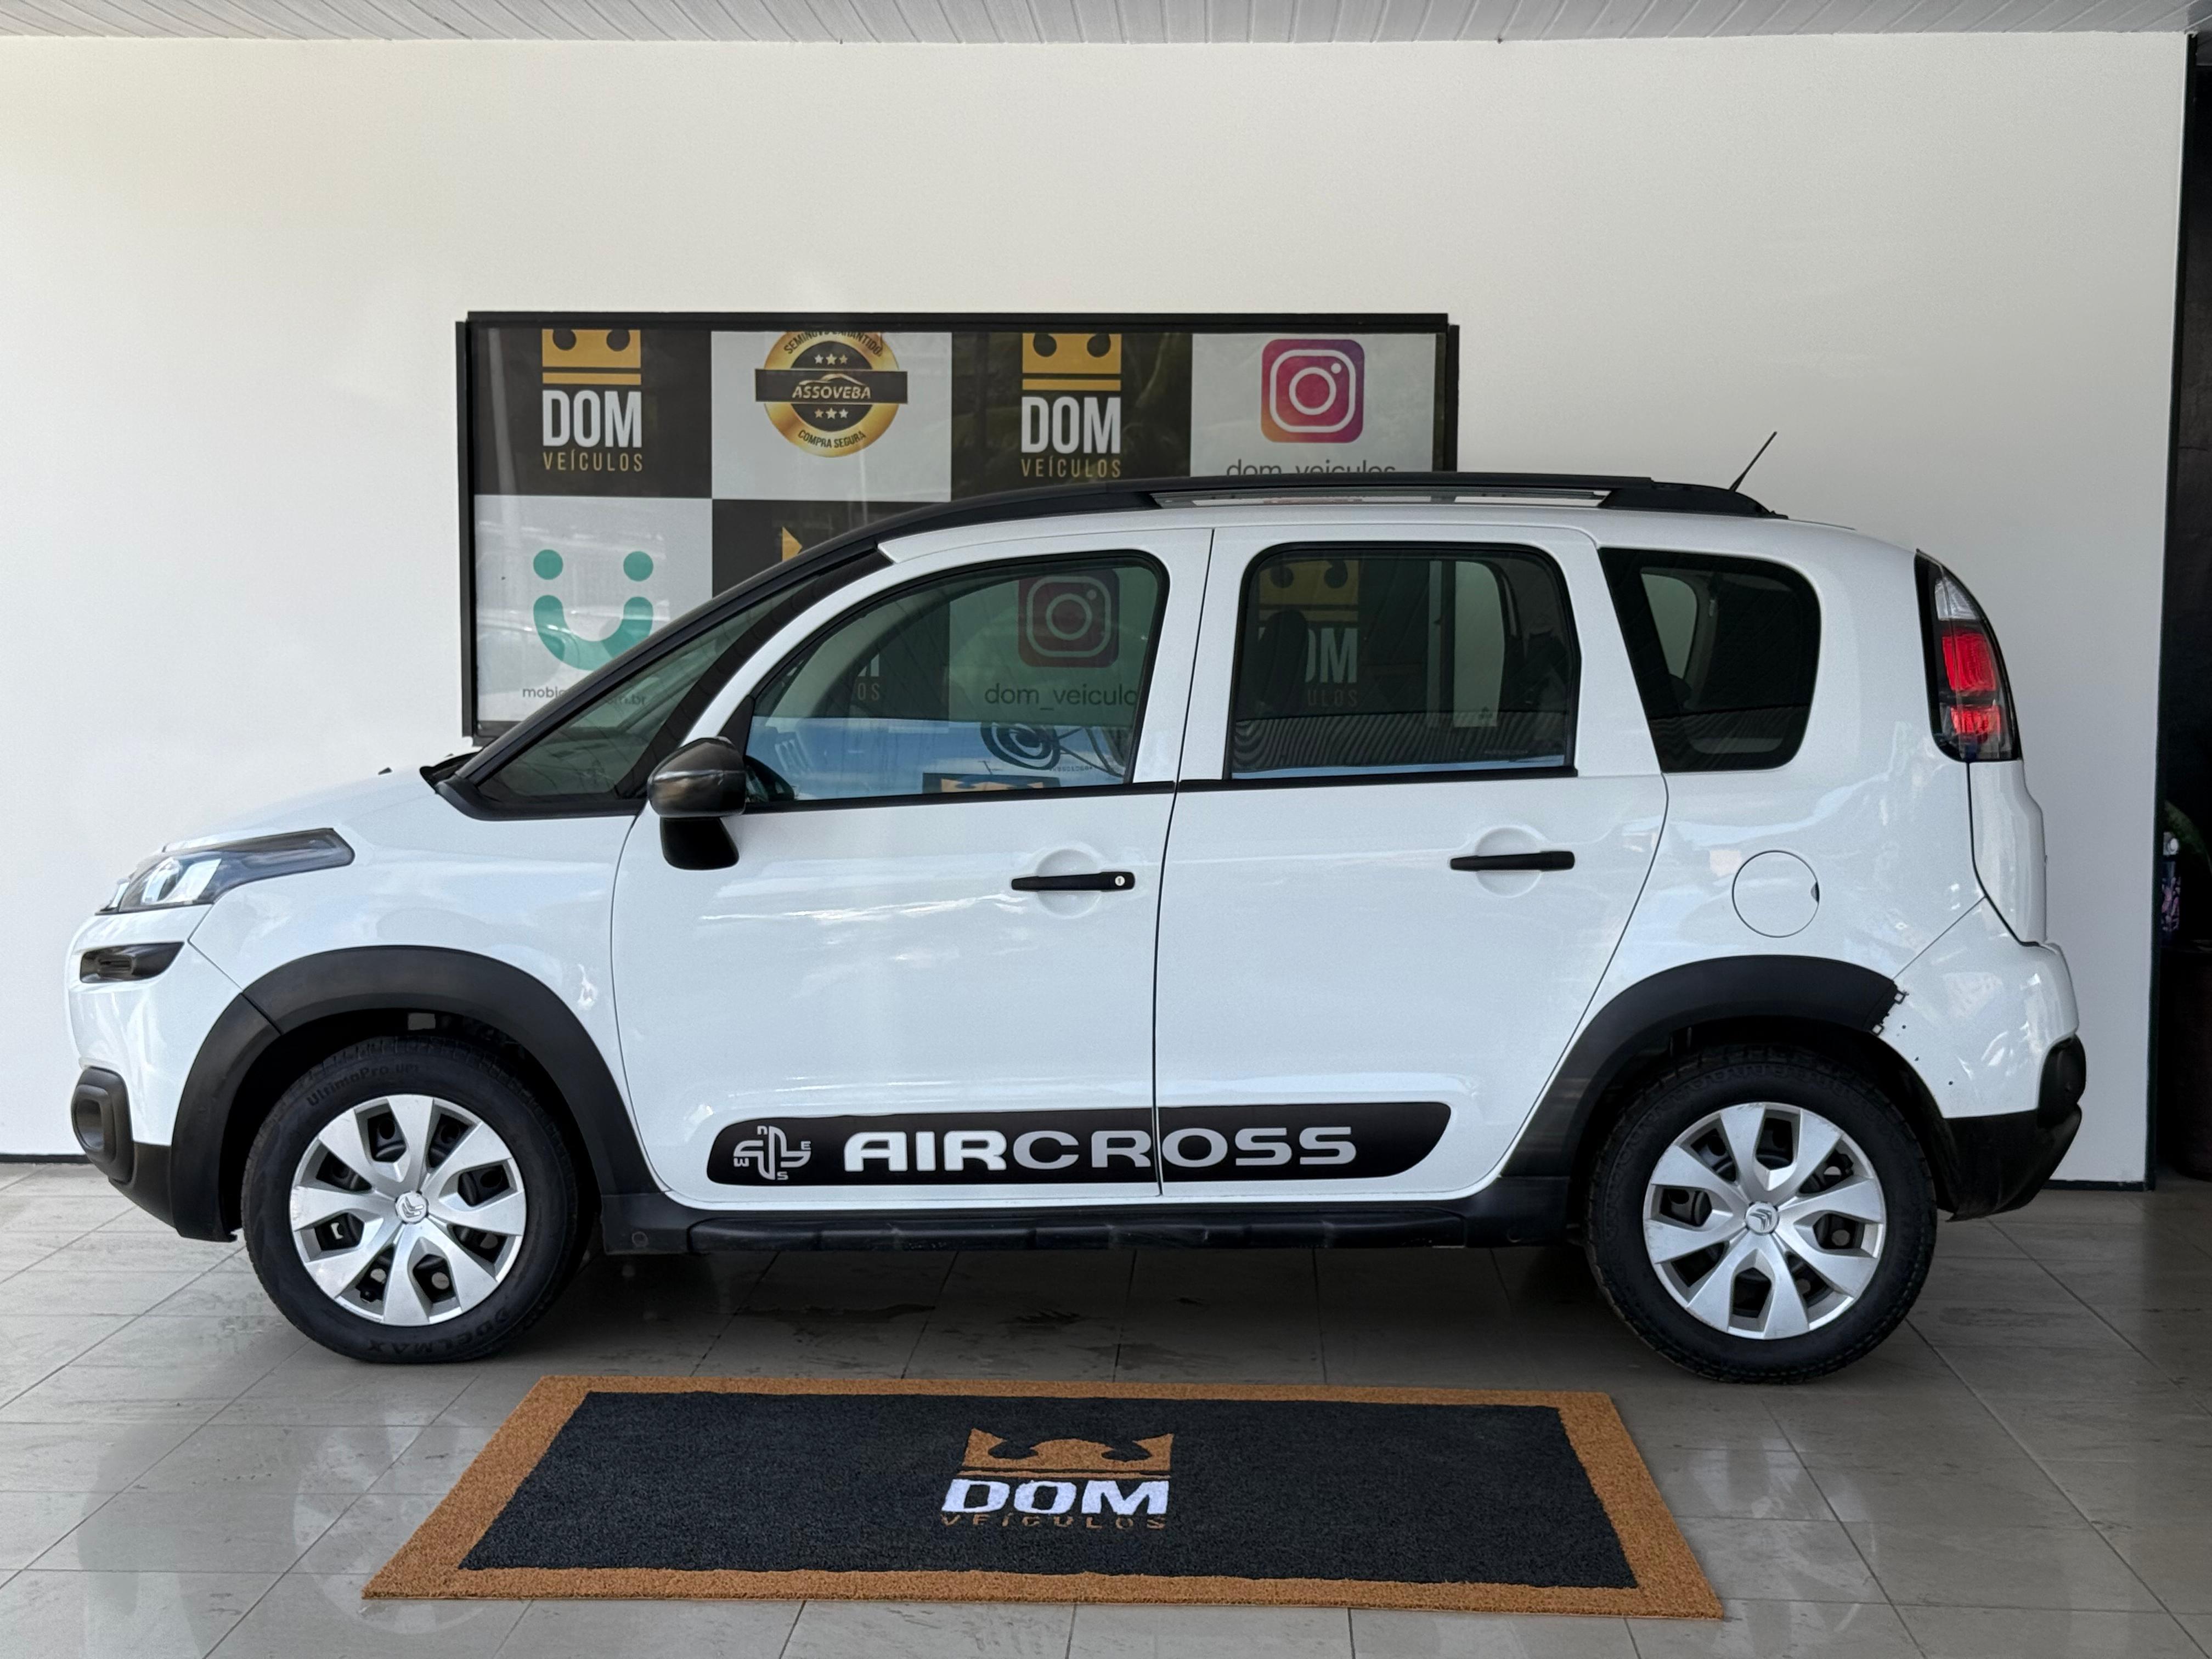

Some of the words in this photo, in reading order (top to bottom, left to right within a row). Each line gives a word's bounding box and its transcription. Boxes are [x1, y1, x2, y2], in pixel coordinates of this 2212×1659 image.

[792, 386, 871, 399] ASSOVEBA
[542, 390, 642, 448] DOM
[1021, 396, 1121, 454] DOM
[798, 430, 832, 448] COMPRA
[833, 431, 866, 448] SEGURA
[543, 449, 643, 472] VEÍCULOS
[1021, 455, 1121, 478] VEÍCULOS
[985, 682, 1139, 710] dom_veiculo
[844, 1126, 1357, 1172] AIRCROSS
[941, 1479, 1169, 1515] DOM
